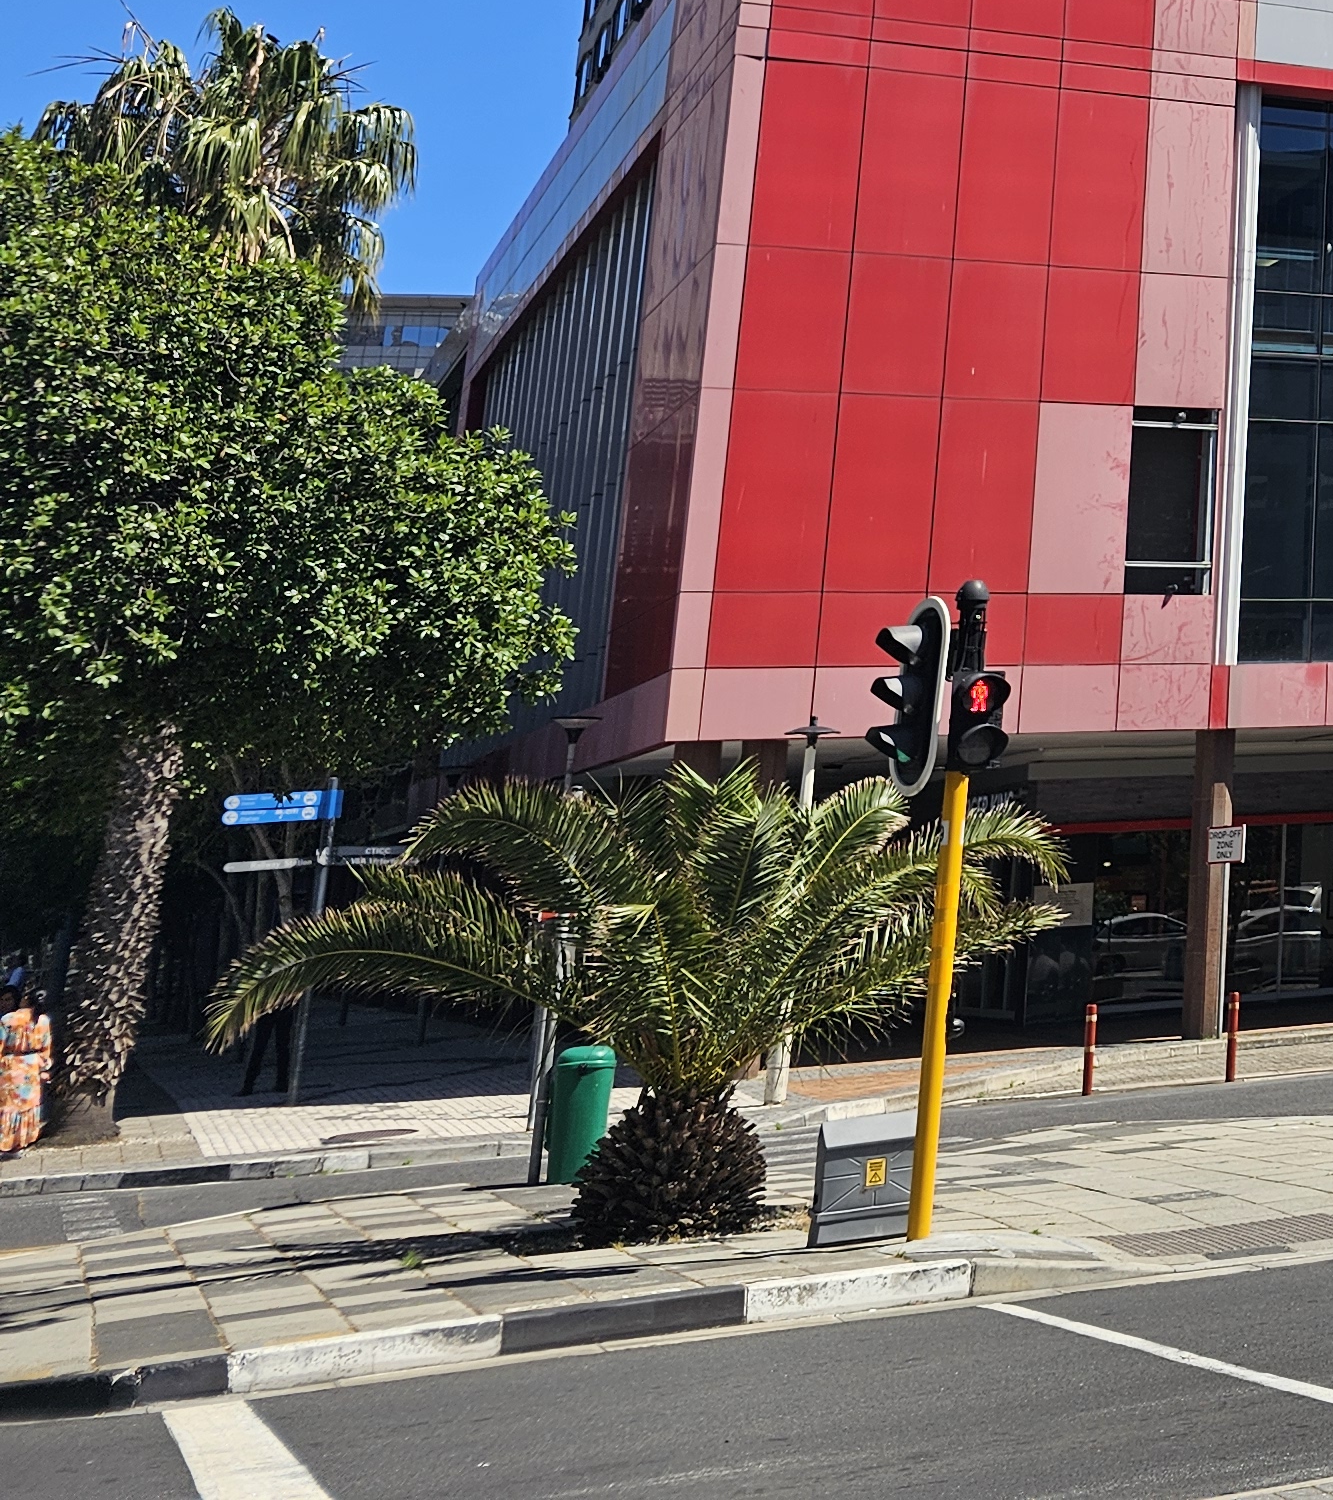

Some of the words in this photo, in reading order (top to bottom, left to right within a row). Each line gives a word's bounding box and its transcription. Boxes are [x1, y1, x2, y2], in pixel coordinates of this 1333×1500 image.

[1209, 829, 1242, 840] DROP-OFF
[1216, 840, 1234, 849] ZONE
[1216, 851, 1234, 859] ONLY
